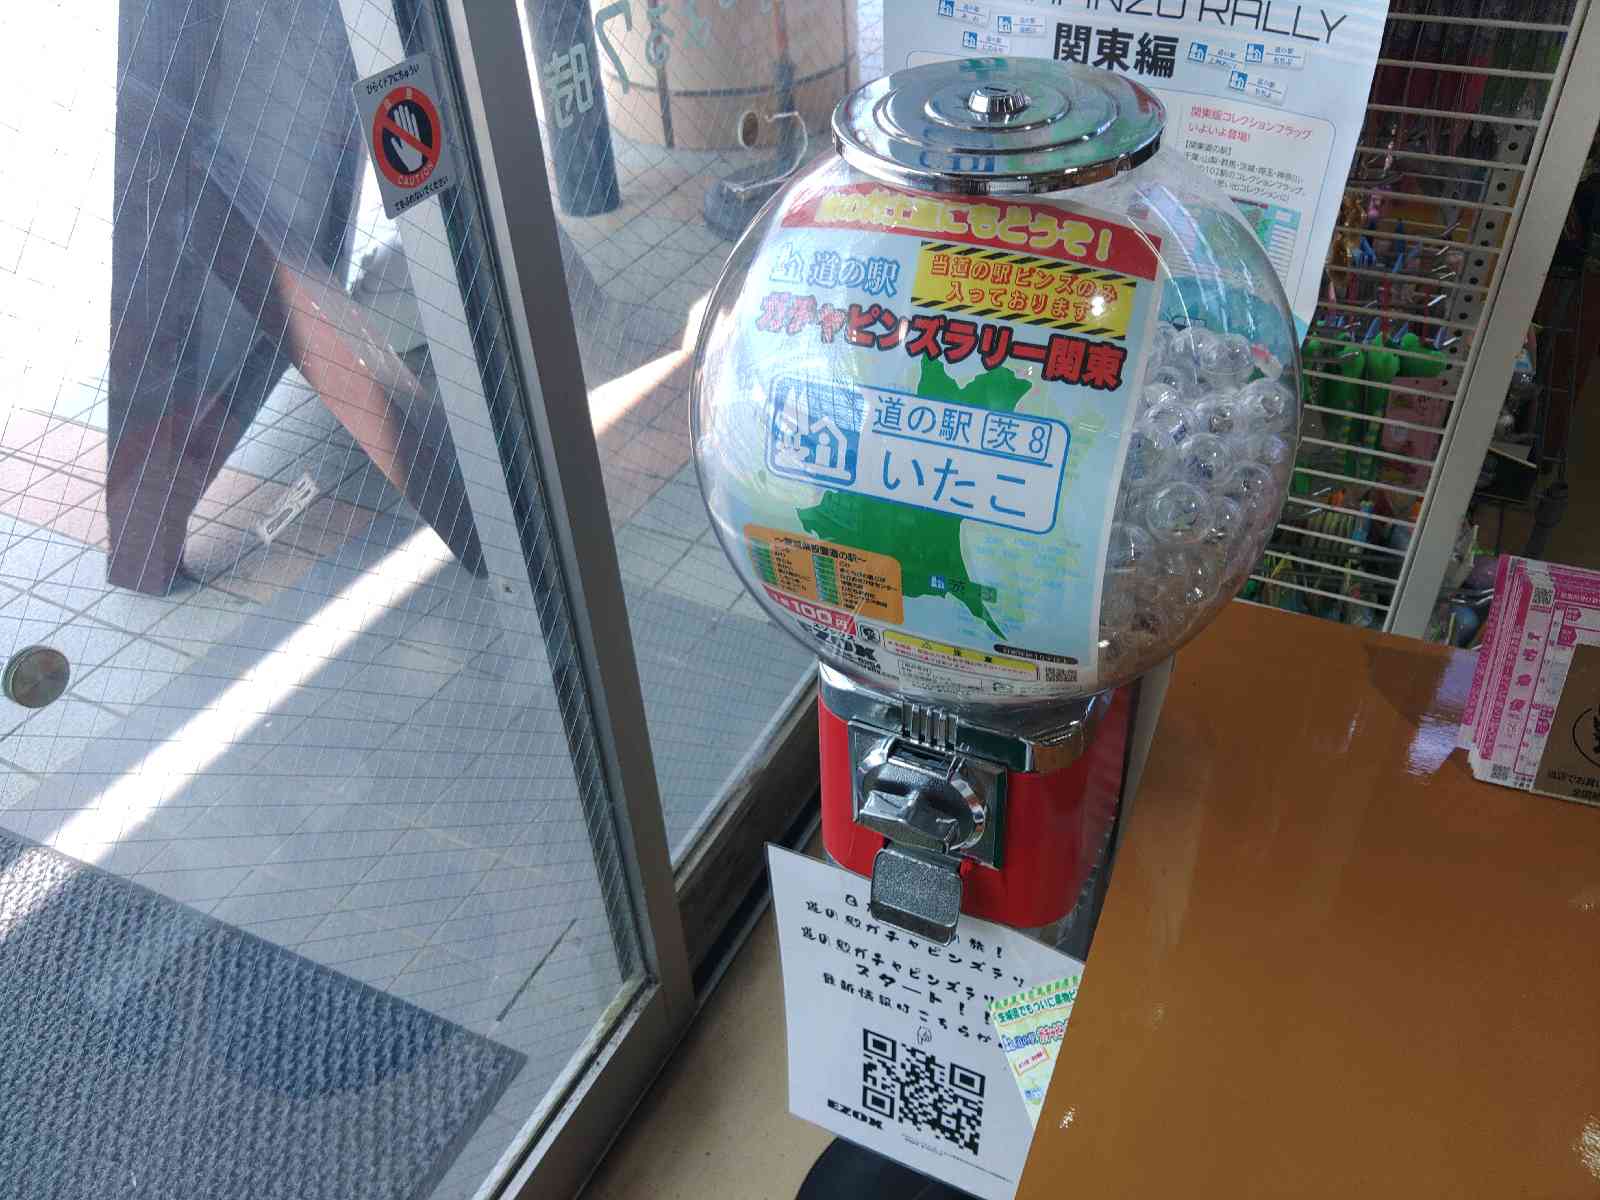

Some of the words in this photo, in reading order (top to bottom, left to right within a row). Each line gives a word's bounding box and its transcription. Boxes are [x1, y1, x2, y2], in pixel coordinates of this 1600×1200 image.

[1198, 0, 1348, 44] RALLY
[1052, 22, 1180, 79] 関東編
[398, 162, 435, 187] CAUTION
[807, 250, 901, 298] 道の駅
[930, 255, 1118, 303] 当道の駅ピンズのみ
[755, 291, 1127, 392] ガチャピンズラリー関東
[872, 395, 973, 444] 道の駅
[882, 449, 1026, 518] いたこ
